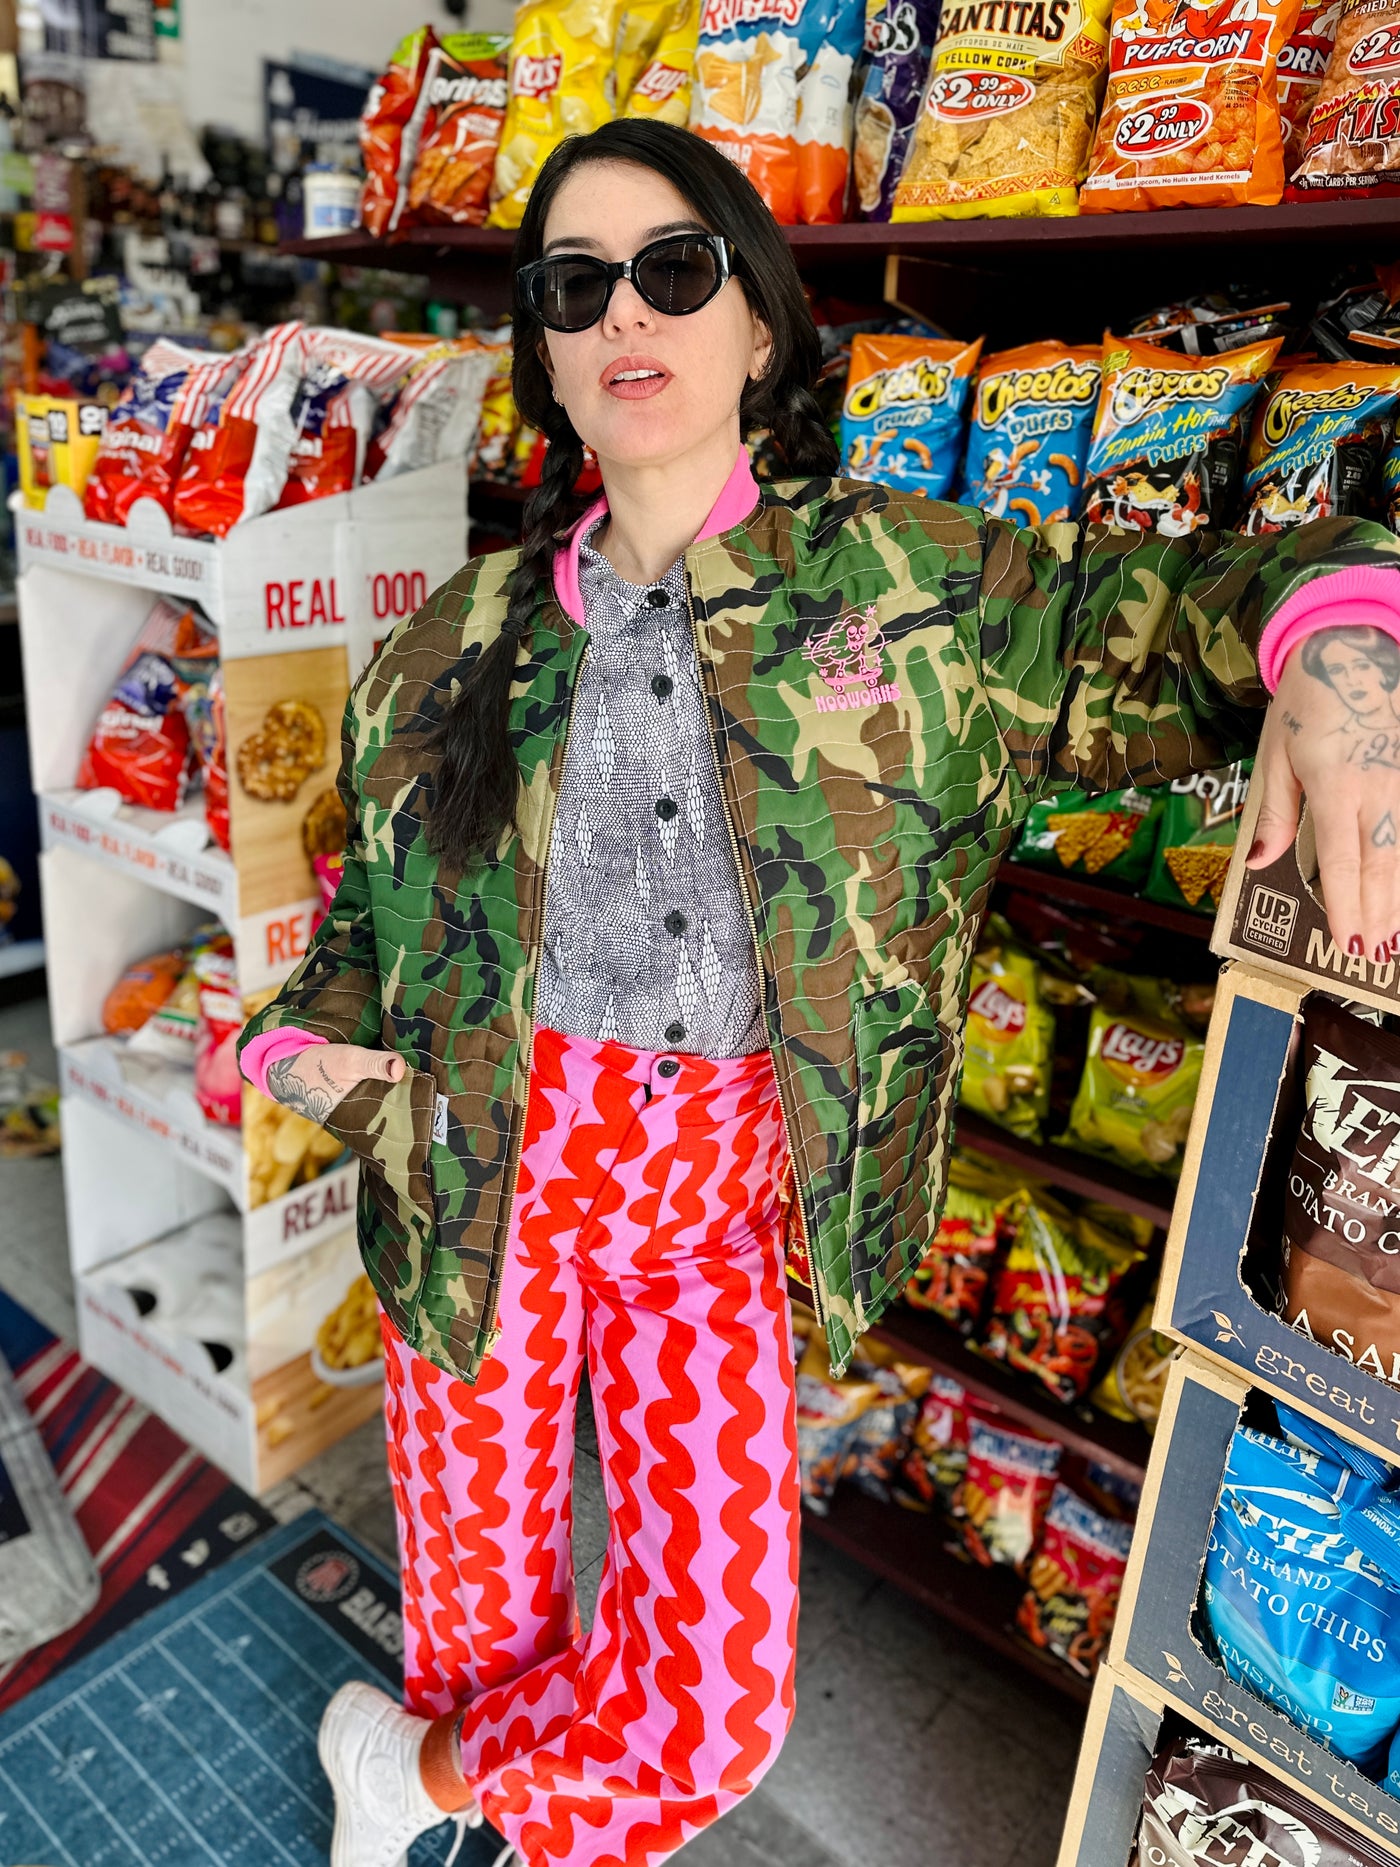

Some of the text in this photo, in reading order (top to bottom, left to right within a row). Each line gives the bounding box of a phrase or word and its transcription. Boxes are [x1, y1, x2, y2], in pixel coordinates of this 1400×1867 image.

[935, 1, 1071, 43] SANTITAS
[945, 53, 992, 65] YELLOW
[1123, 30, 1251, 66] PUFFCORN
[971, 94, 1022, 109] ONLY
[1154, 120, 1201, 141] ONLY
[1173, 175, 1188, 183] Hulls
[1215, 172, 1240, 181] Kernels
[1345, 175, 1357, 187] PER
[979, 360, 1102, 428] Cheetos
[1112, 367, 1231, 425] Cheetos
[1173, 405, 1218, 435] Hot
[1263, 382, 1379, 446] Cheetos
[264, 570, 427, 632] REAL OOD
[1255, 892, 1292, 925] UP
[1249, 930, 1285, 950] CERTIFIED
[1252, 917, 1287, 938] CYCLED
[283, 1181, 354, 1243] REAL
[1254, 1345, 1376, 1425] great
[1361, 1508, 1397, 1538] PROMISE
[1245, 1546, 1332, 1591] BRAND
[1297, 1601, 1387, 1663] CHIPS
[1201, 1689, 1313, 1776] great
